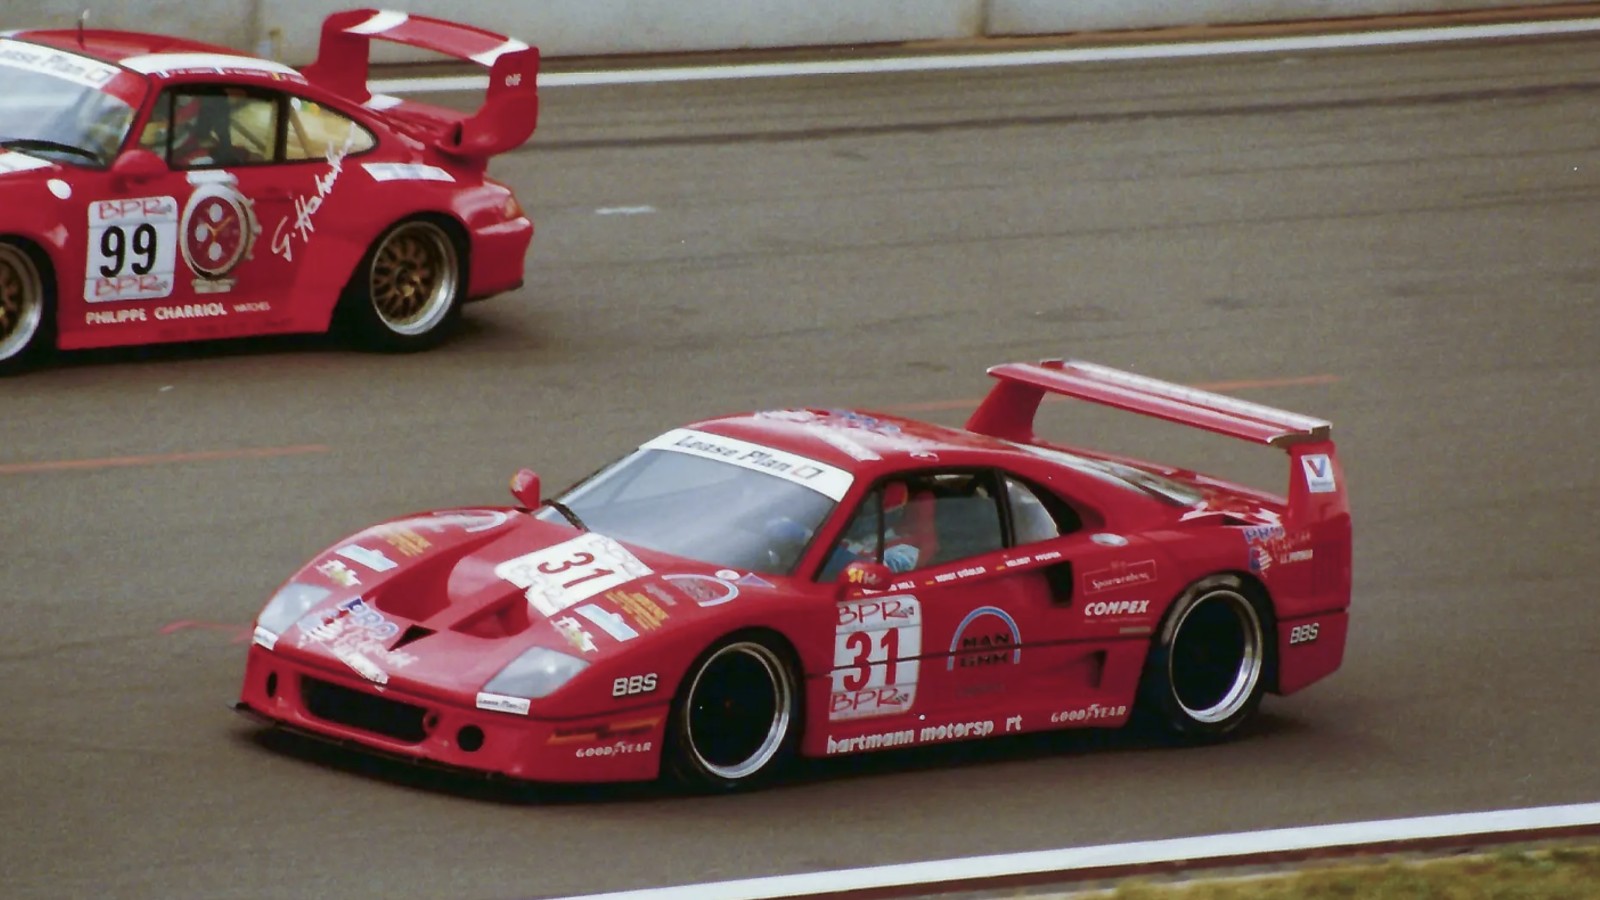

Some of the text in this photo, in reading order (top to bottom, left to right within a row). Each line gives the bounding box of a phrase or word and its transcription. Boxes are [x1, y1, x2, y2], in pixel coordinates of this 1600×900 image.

[98, 199, 171, 220] BPR
[100, 223, 157, 279] 99
[95, 276, 168, 297] BPR
[86, 308, 147, 325] PHILIPPE
[154, 303, 228, 320] CHARRIOL
[674, 436, 792, 472] Lease Plan
[537, 551, 616, 589] 31
[838, 601, 908, 625] BPR
[1084, 600, 1149, 617] COMPEX
[1289, 623, 1320, 644] BBS
[843, 627, 899, 692] 31
[612, 673, 657, 697] BBS
[831, 688, 902, 713] BPR
[827, 735, 914, 754] hartmann
